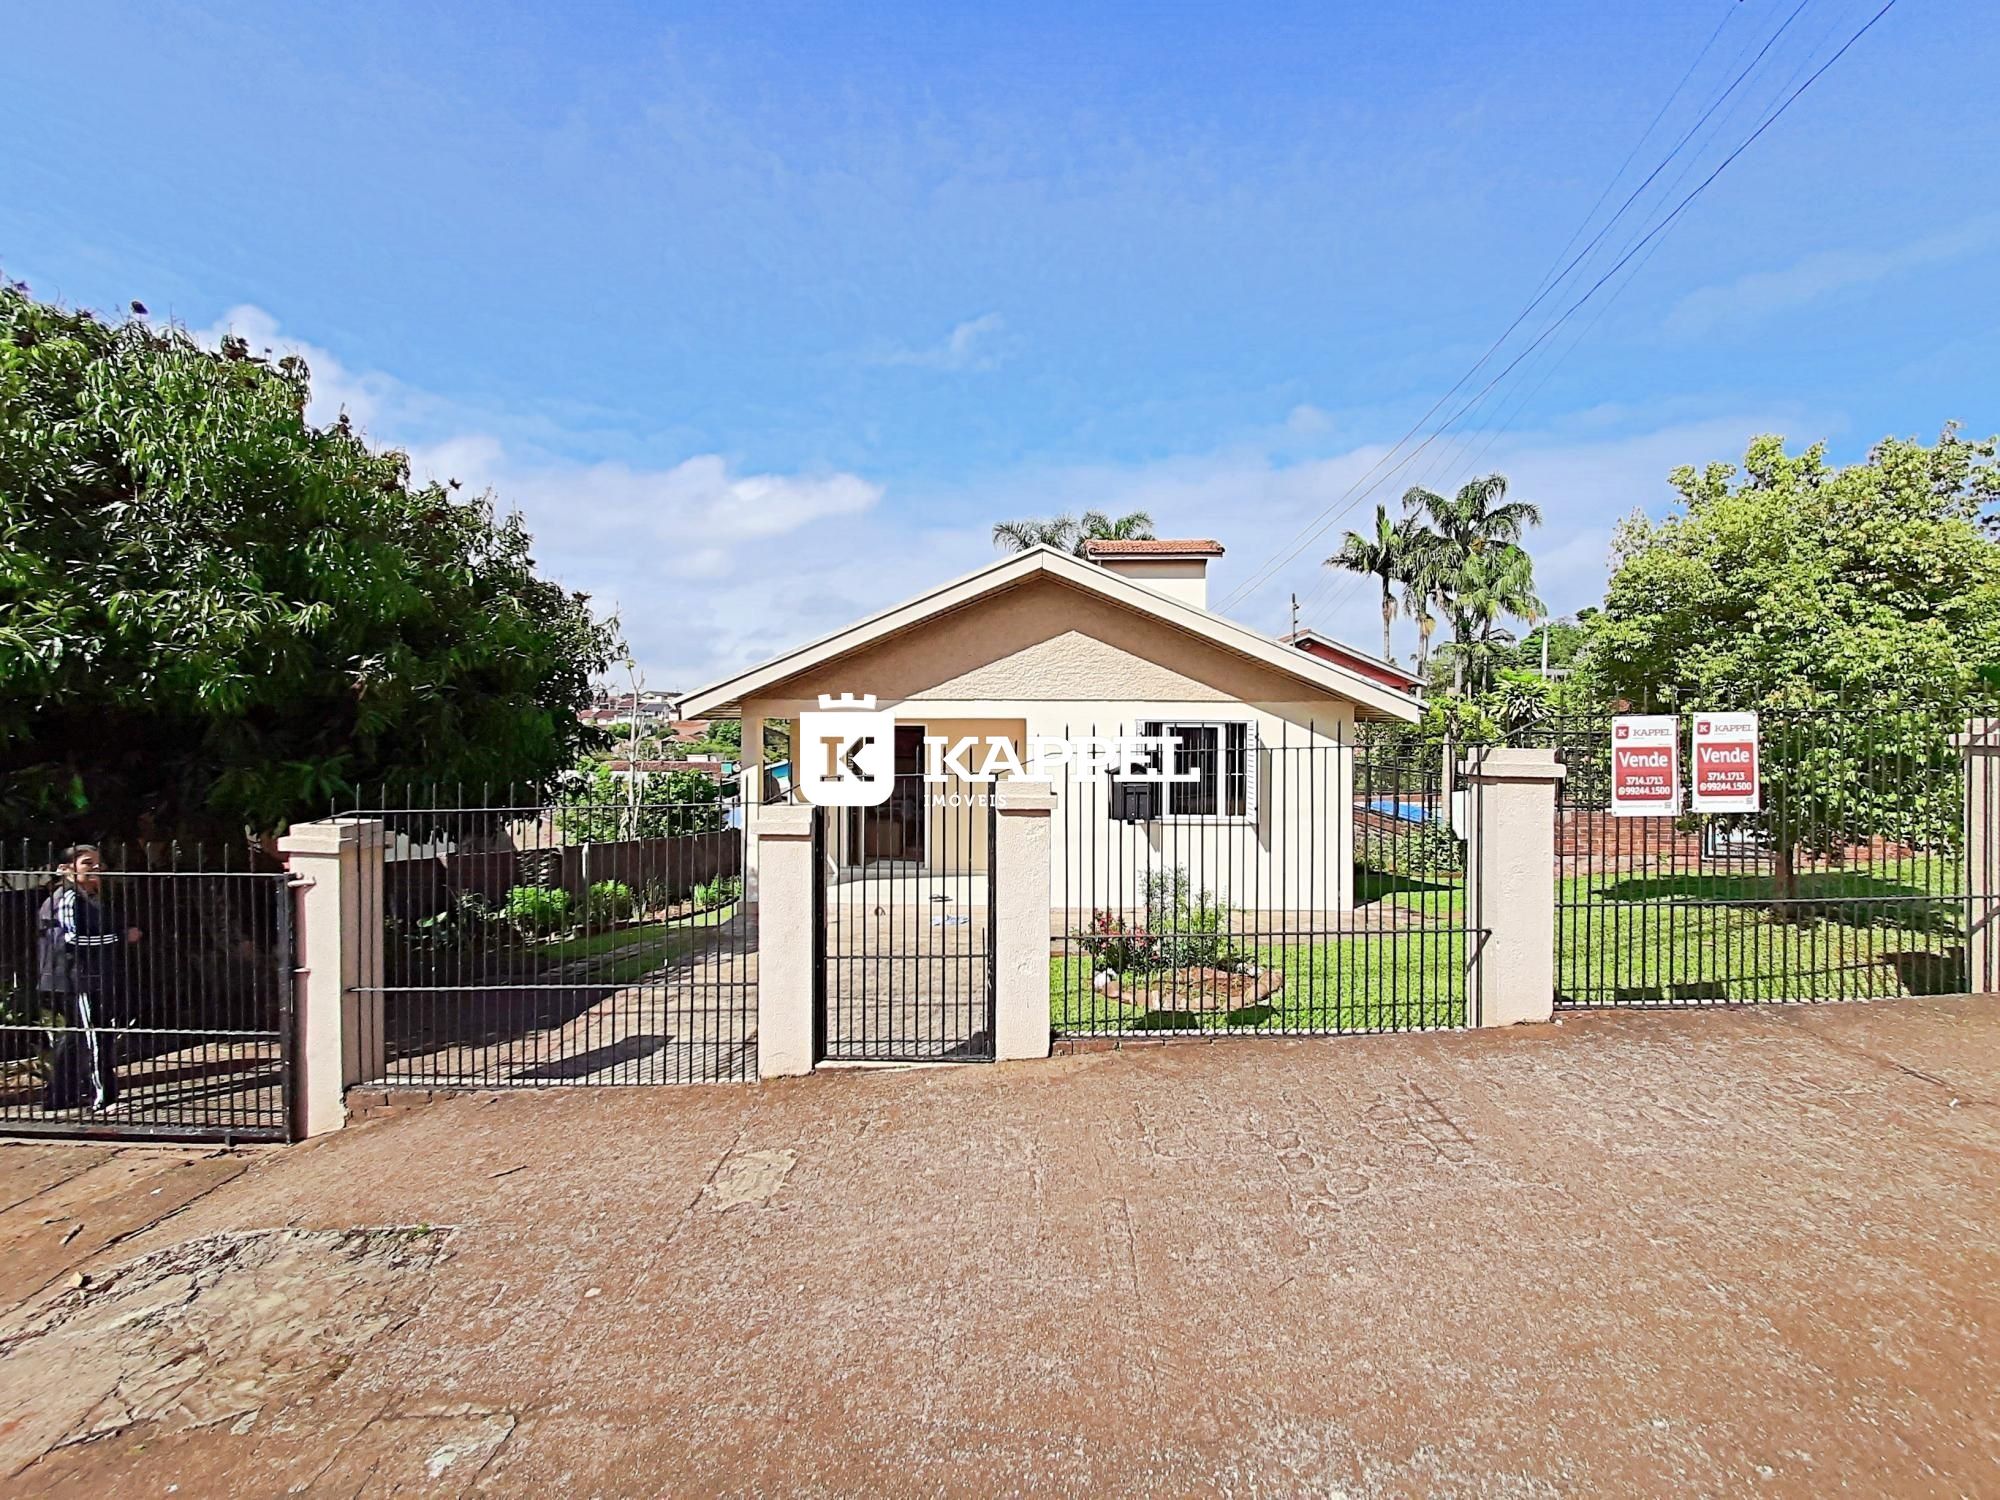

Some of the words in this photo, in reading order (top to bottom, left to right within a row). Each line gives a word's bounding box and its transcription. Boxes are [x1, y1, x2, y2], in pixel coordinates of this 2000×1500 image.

[1633, 728, 1672, 736] KAPPEL
[1715, 724, 1754, 732] KAPPEL
[1618, 751, 1668, 767] Vende
[1700, 747, 1750, 763] Vende
